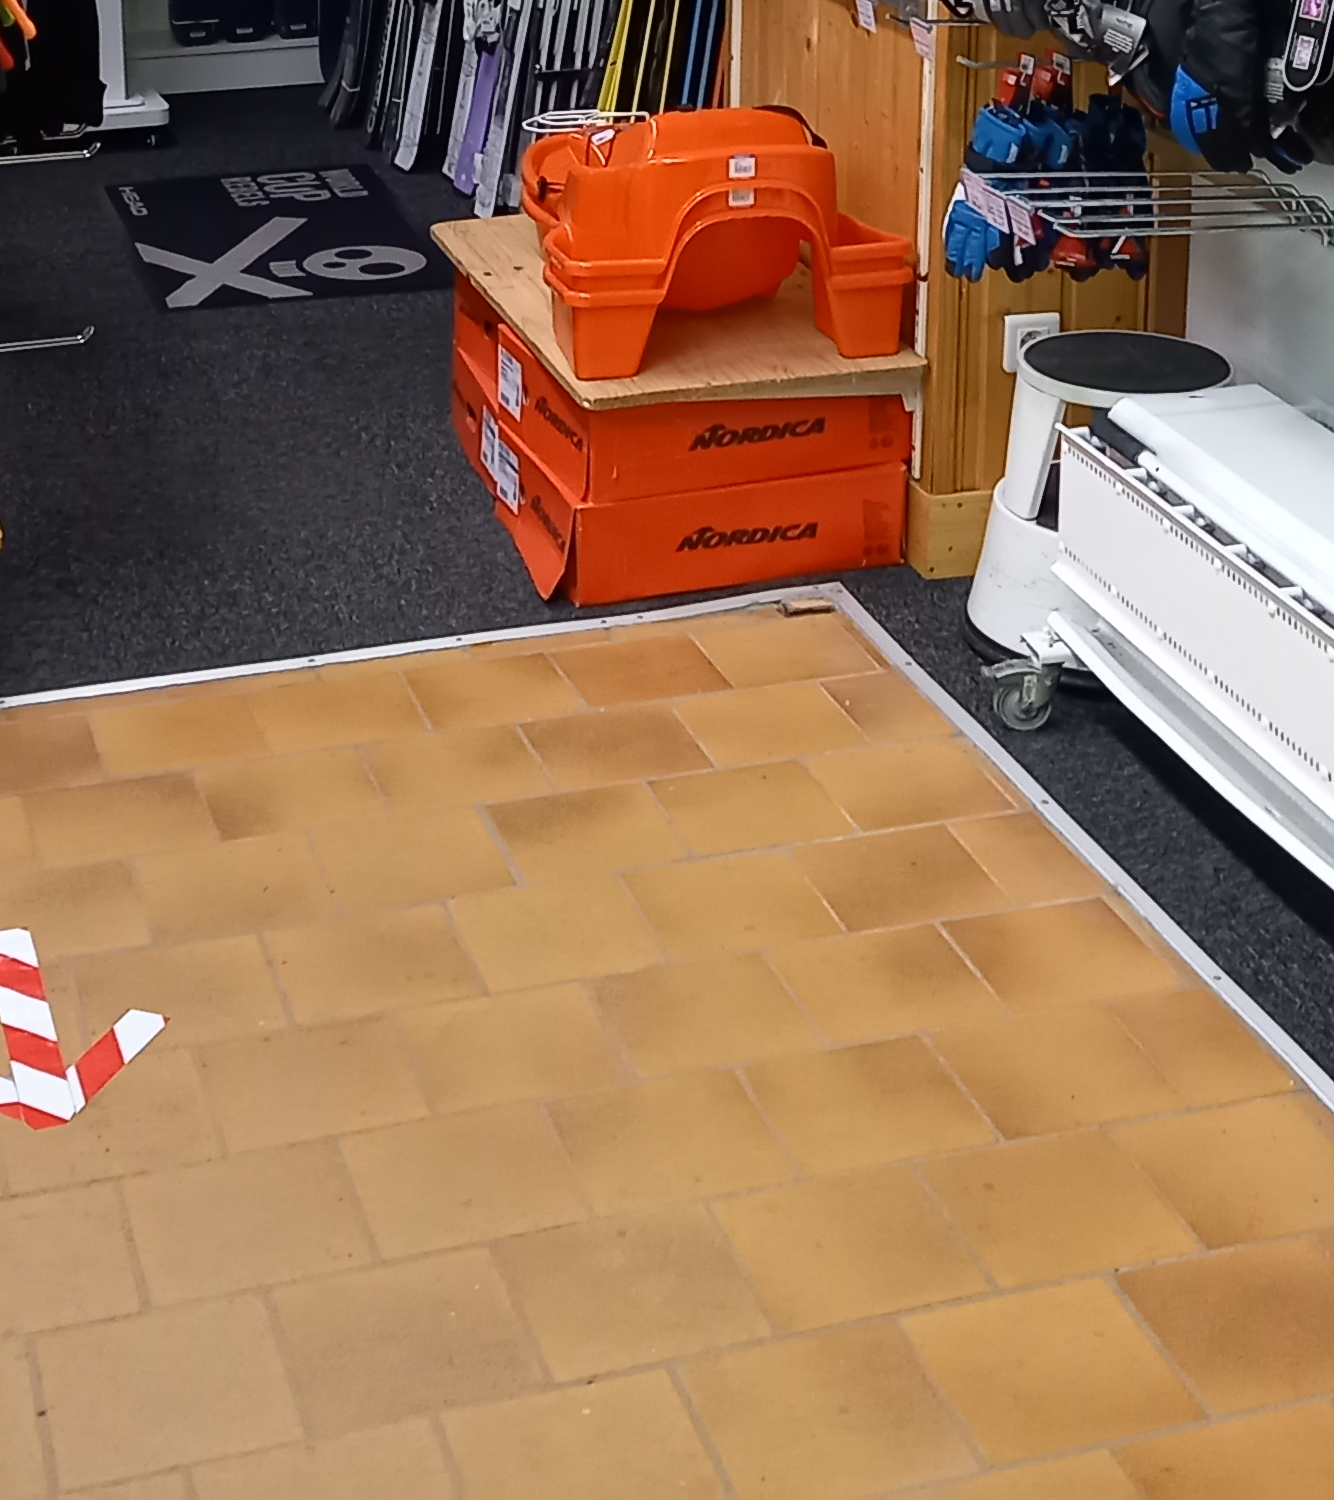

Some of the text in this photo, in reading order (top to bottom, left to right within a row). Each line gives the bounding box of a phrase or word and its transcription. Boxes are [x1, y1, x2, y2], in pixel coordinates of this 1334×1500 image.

[118, 186, 149, 217] HEAD
[257, 171, 332, 201] CUP
[688, 416, 827, 452] NORDICA
[676, 522, 819, 553] NORDICA
